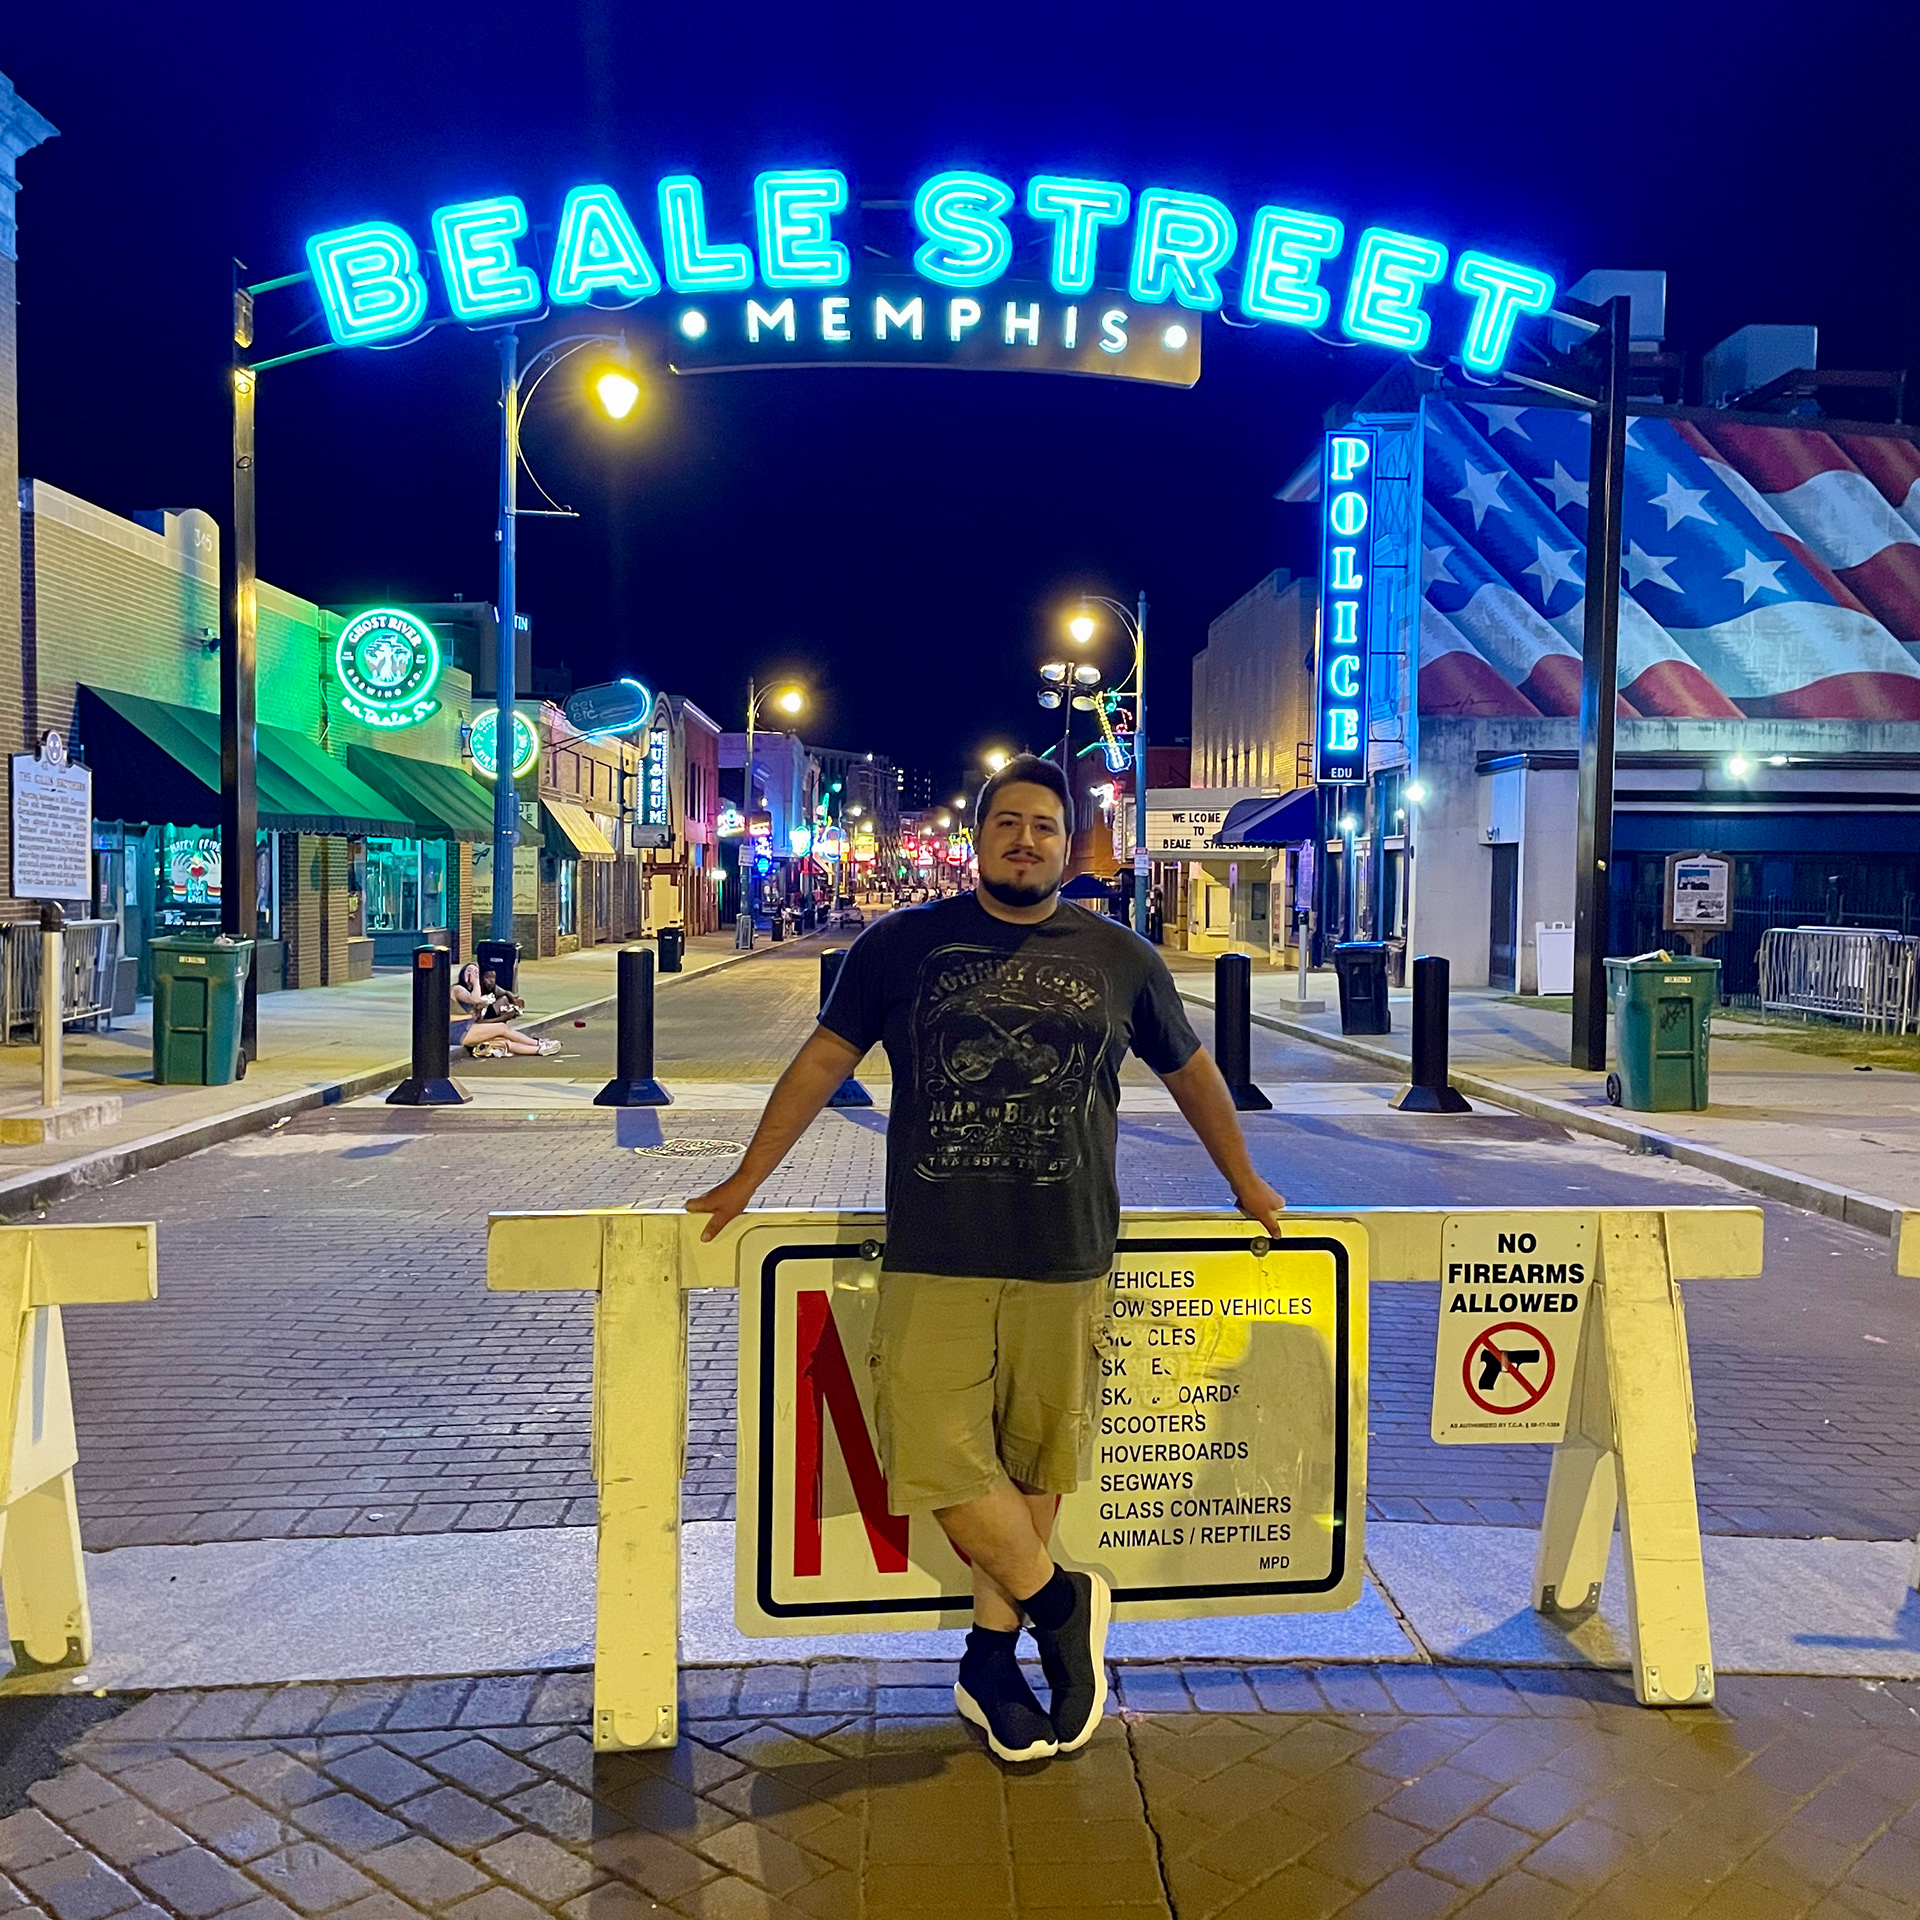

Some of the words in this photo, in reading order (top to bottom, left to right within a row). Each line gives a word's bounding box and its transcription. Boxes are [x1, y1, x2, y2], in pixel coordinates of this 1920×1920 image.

[305, 169, 851, 346] BEALE
[914, 170, 1556, 374] STREET
[747, 297, 1128, 354] MEMPHIS
[1328, 437, 1371, 750] POLICE
[348, 615, 388, 643] GHOST
[388, 617, 422, 647] RIVER
[649, 731, 664, 824] MUSEUM
[1331, 767, 1353, 779] EDU
[1193, 826, 1205, 836] TO
[1163, 839, 1192, 849] BEALE
[929, 1101, 982, 1123] MAN
[1498, 1232, 1538, 1254] NO
[1449, 1263, 1585, 1284] FIREARMS
[1104, 1300, 1145, 1319] OW
[1151, 1299, 1214, 1317] SPEED
[1220, 1298, 1312, 1315] VEHICLES
[1450, 1293, 1579, 1313] ALLOWED
[794, 1290, 910, 1577] N
[1101, 1414, 1206, 1435] SCOOTERS
[1101, 1442, 1249, 1464] HOVERBOARDS
[1100, 1472, 1193, 1492] SEGWAYS
[1099, 1501, 1164, 1520] GLASS
[1170, 1497, 1292, 1517] CONTAINERS
[1098, 1528, 1184, 1549] ANIMALS
[1201, 1524, 1291, 1544] REPTILES
[1259, 1556, 1290, 1569] MPD
